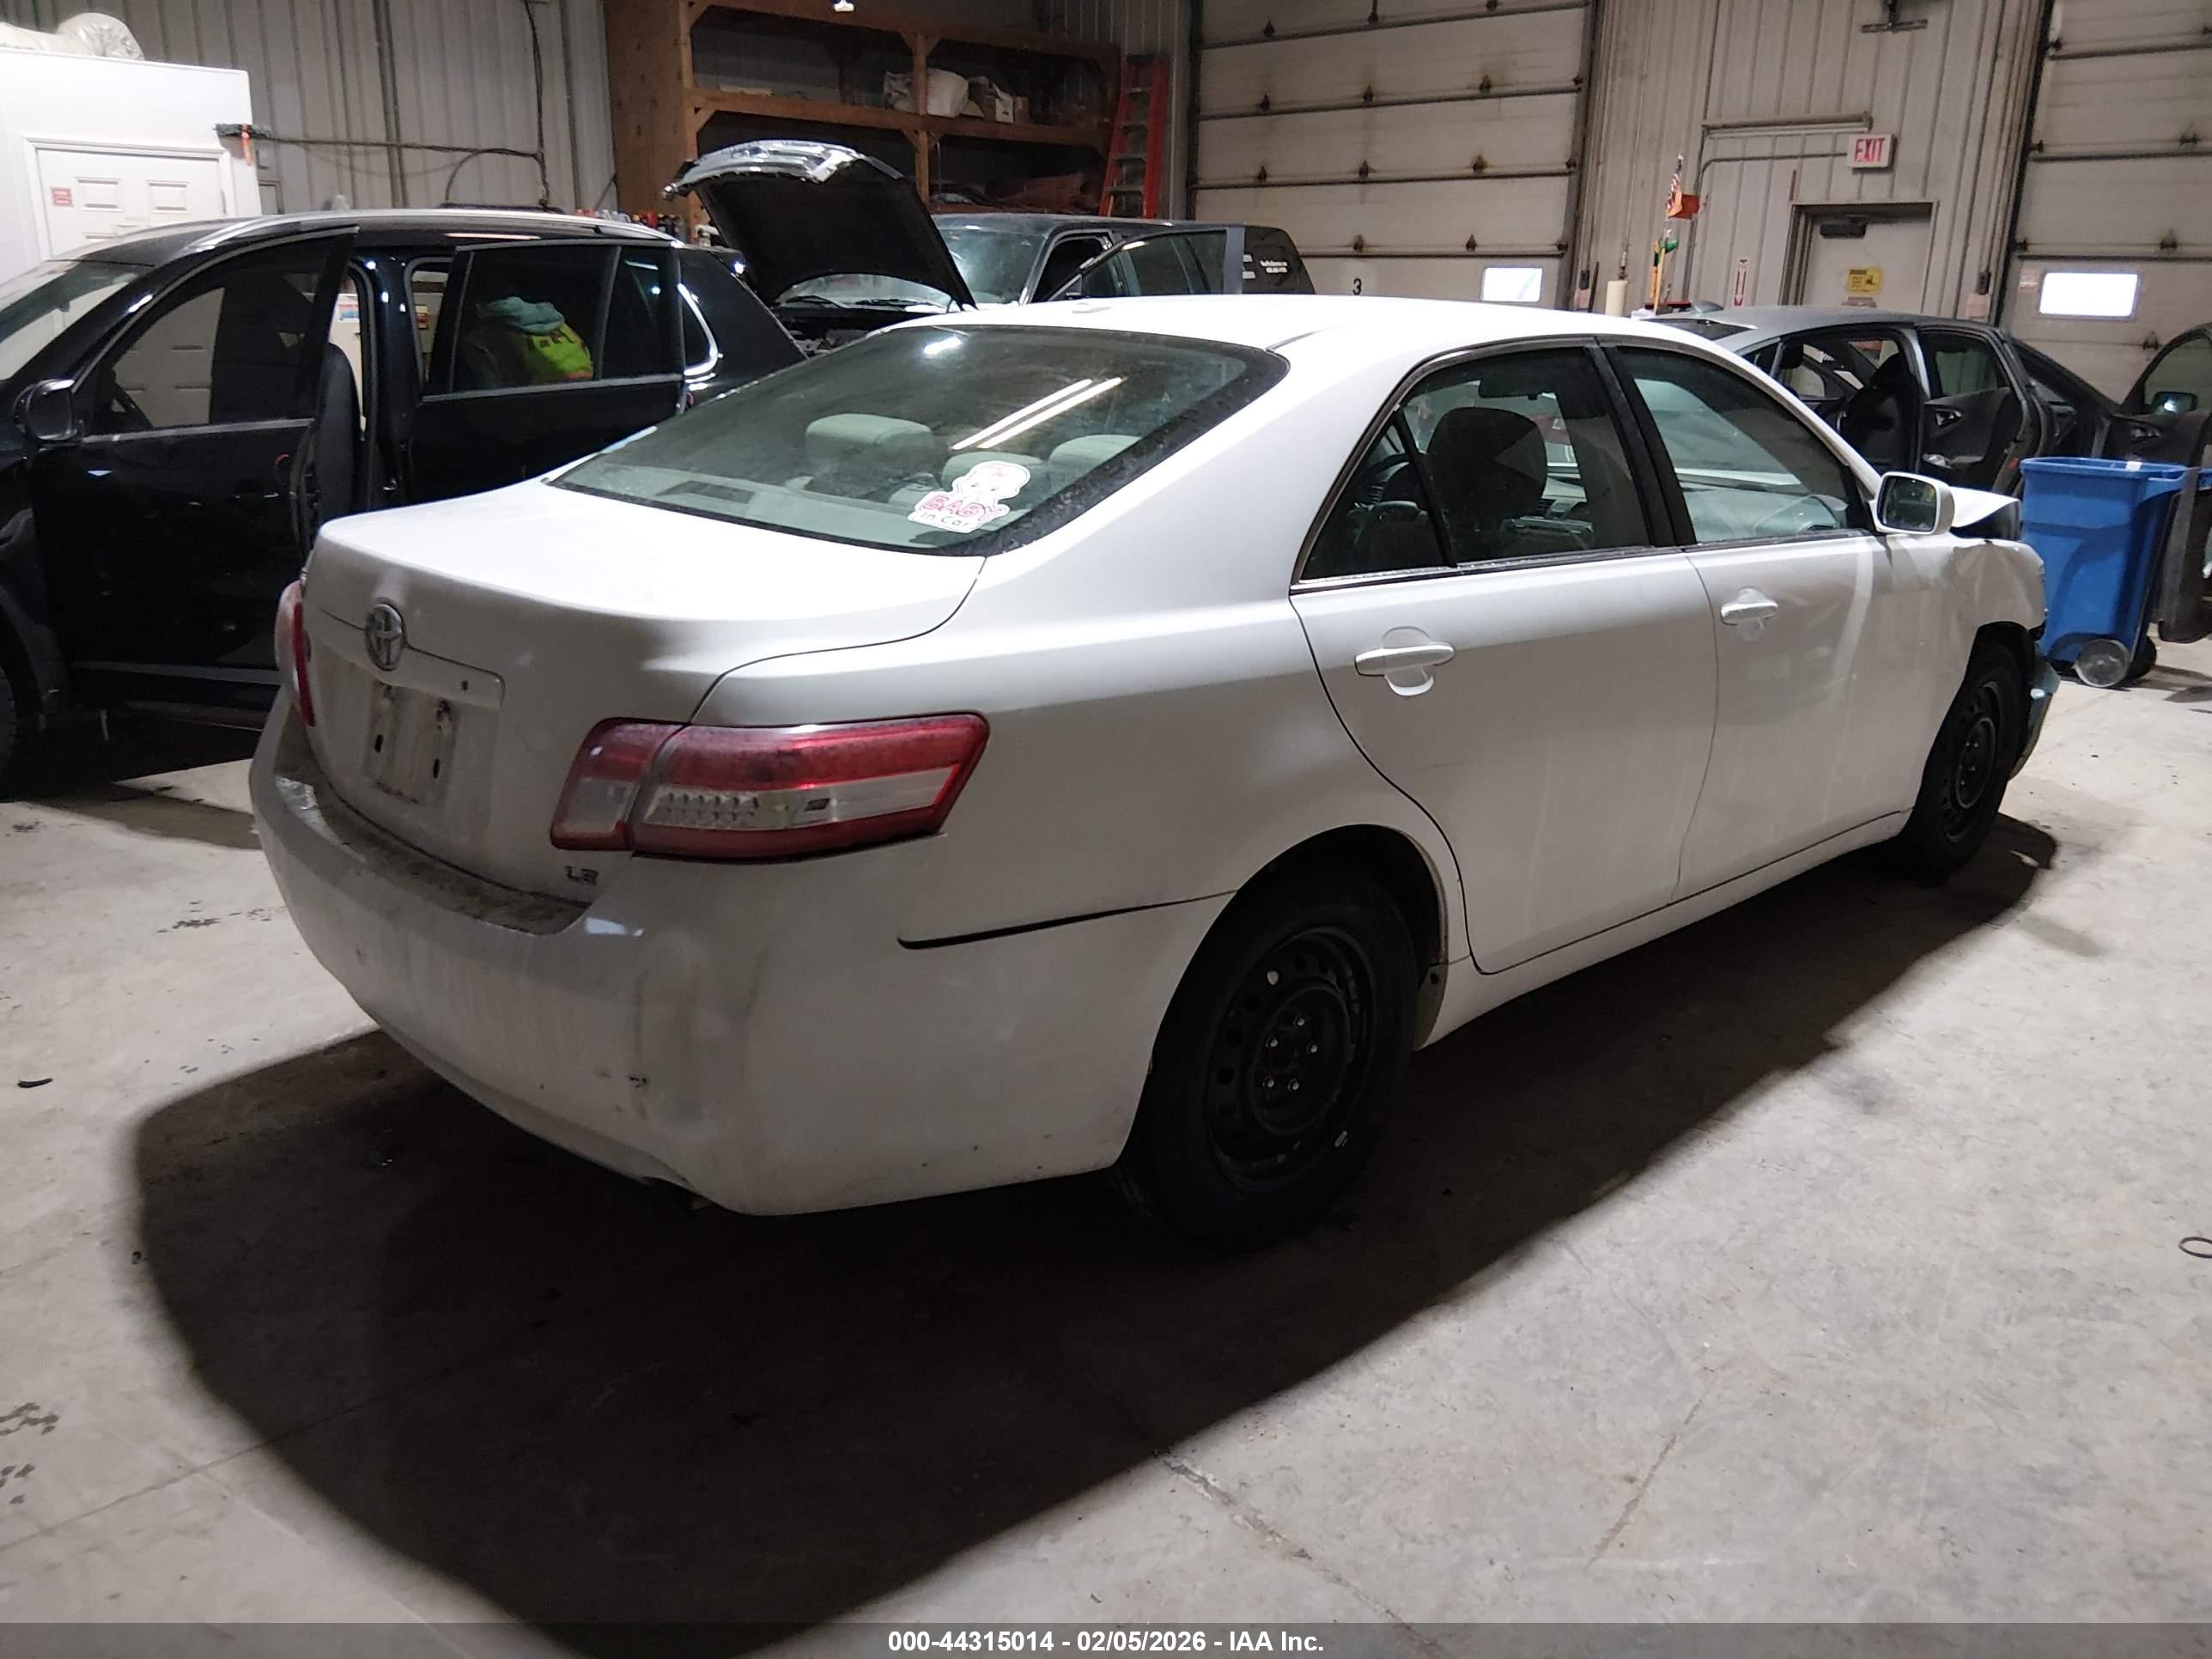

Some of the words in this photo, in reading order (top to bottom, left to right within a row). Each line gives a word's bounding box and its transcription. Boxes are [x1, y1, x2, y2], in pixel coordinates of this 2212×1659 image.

[1855, 137, 1886, 162] EXIT
[1352, 278, 1362, 295] 3
[920, 495, 1004, 522] BABY
[566, 865, 599, 886] LE
